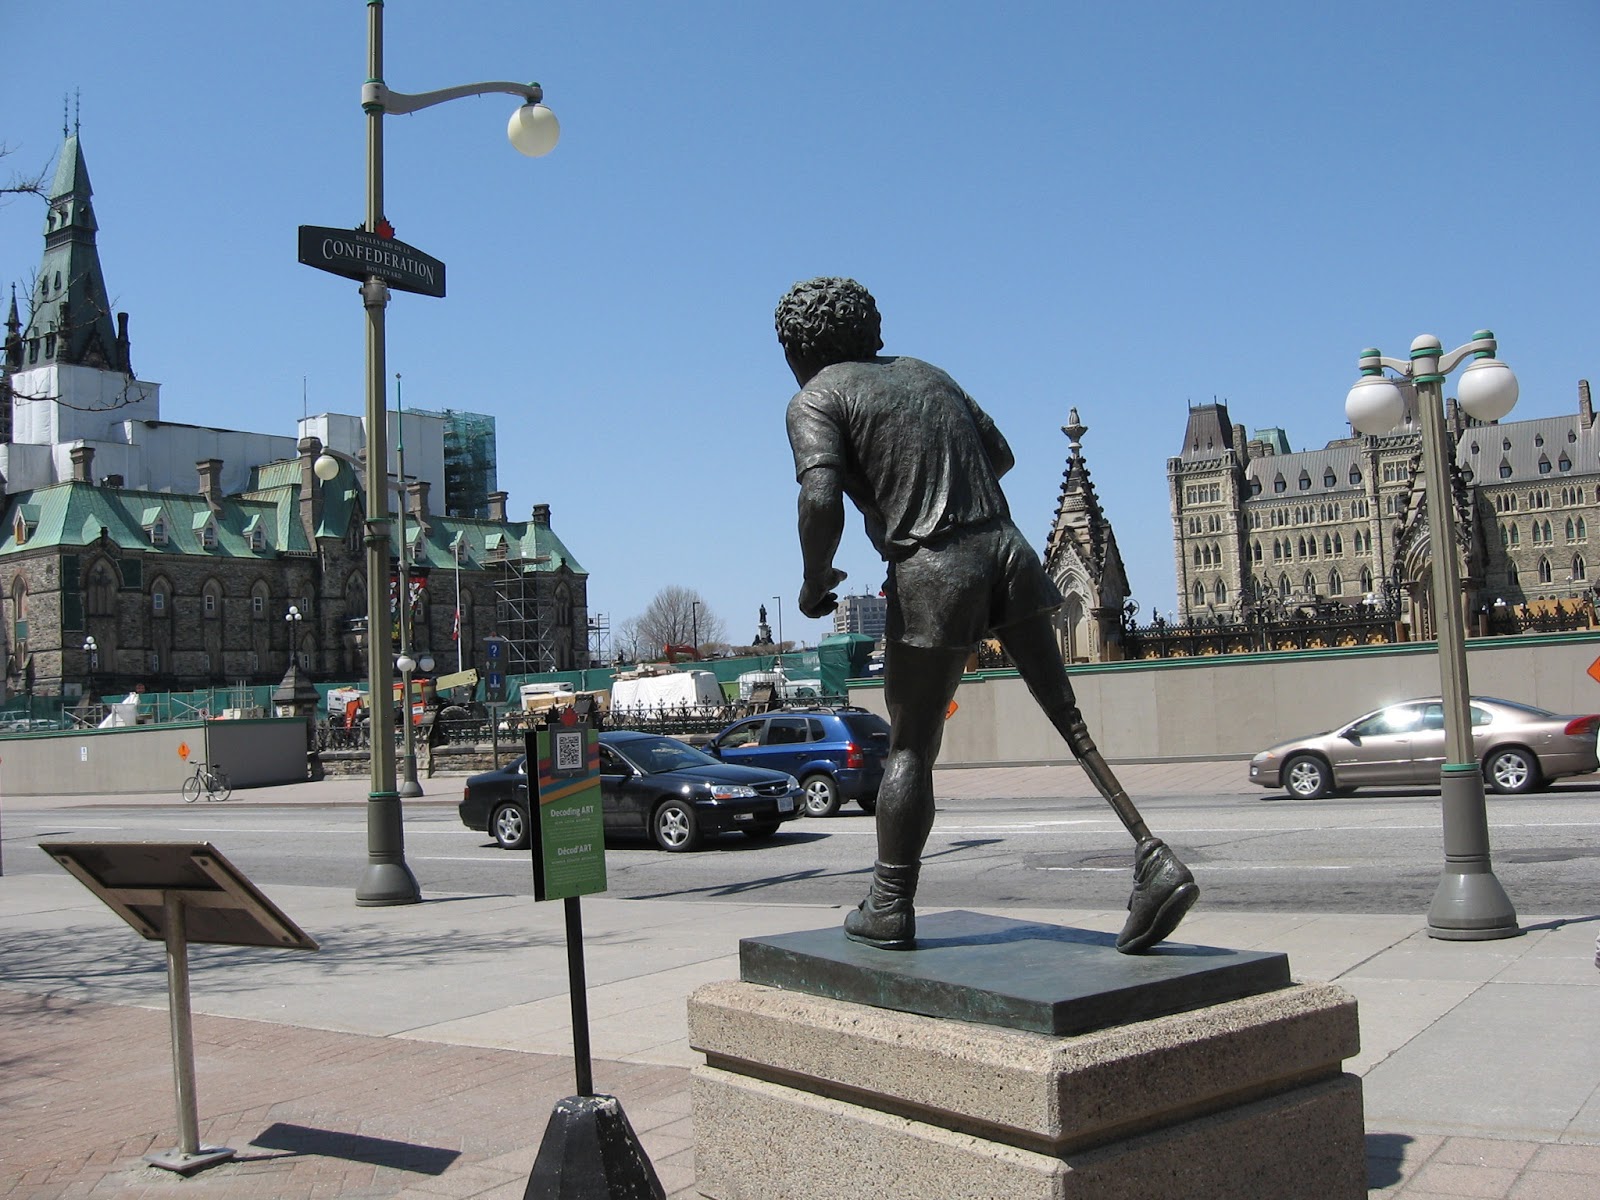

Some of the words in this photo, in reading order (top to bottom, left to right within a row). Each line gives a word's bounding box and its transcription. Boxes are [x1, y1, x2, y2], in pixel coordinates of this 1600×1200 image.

[355, 235, 393, 249] BOULEVARD
[322, 239, 434, 285] CONFEDERATION
[366, 265, 402, 279] BOULEVARD
[550, 807, 580, 817] Decoding
[581, 805, 594, 814] ART
